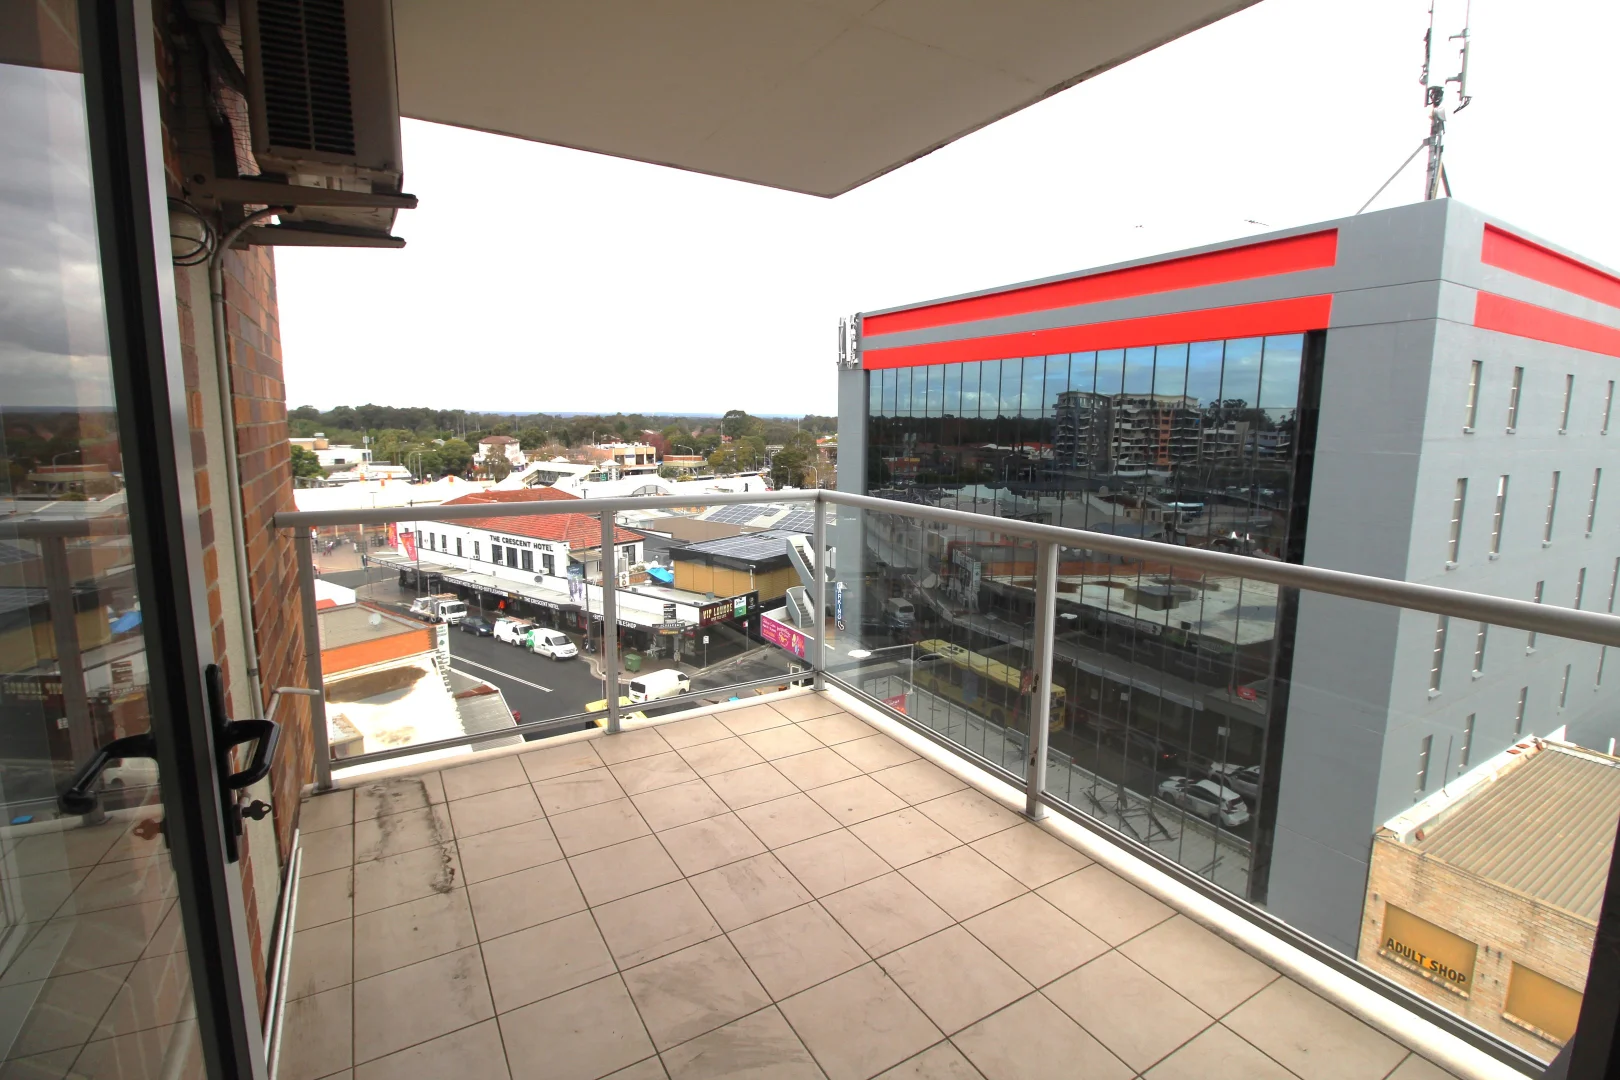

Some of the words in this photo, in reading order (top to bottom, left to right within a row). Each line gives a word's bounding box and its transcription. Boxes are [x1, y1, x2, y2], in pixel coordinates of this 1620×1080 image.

[489, 534, 501, 543] THE
[501, 536, 531, 548] CRESCENT
[533, 542, 554, 552] HOTEL
[702, 608, 712, 620] VIP
[713, 602, 733, 617] LOUNGE
[1387, 937, 1425, 964] ADULT
[1430, 960, 1466, 984] SHOP
